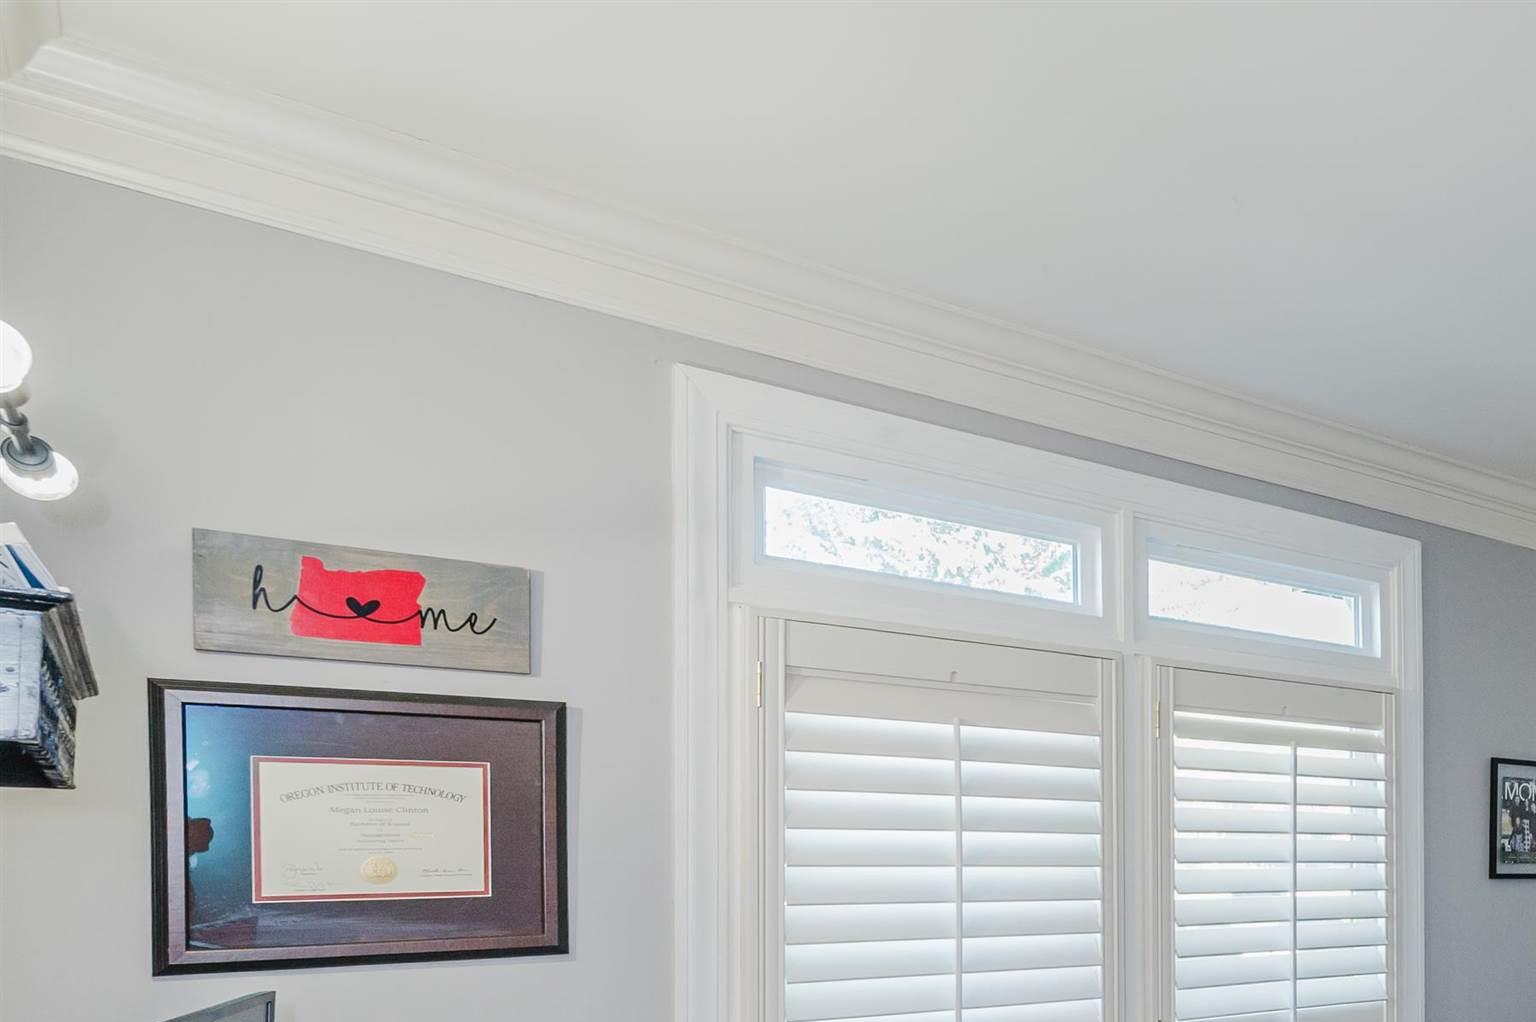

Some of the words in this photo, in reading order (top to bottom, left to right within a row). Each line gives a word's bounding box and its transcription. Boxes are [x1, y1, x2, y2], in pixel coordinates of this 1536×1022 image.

[279, 786, 325, 804] OREGON
[327, 782, 383, 794] INSTITUTE
[385, 782, 400, 792] OF
[401, 783, 468, 804] TECHNOLOGY
